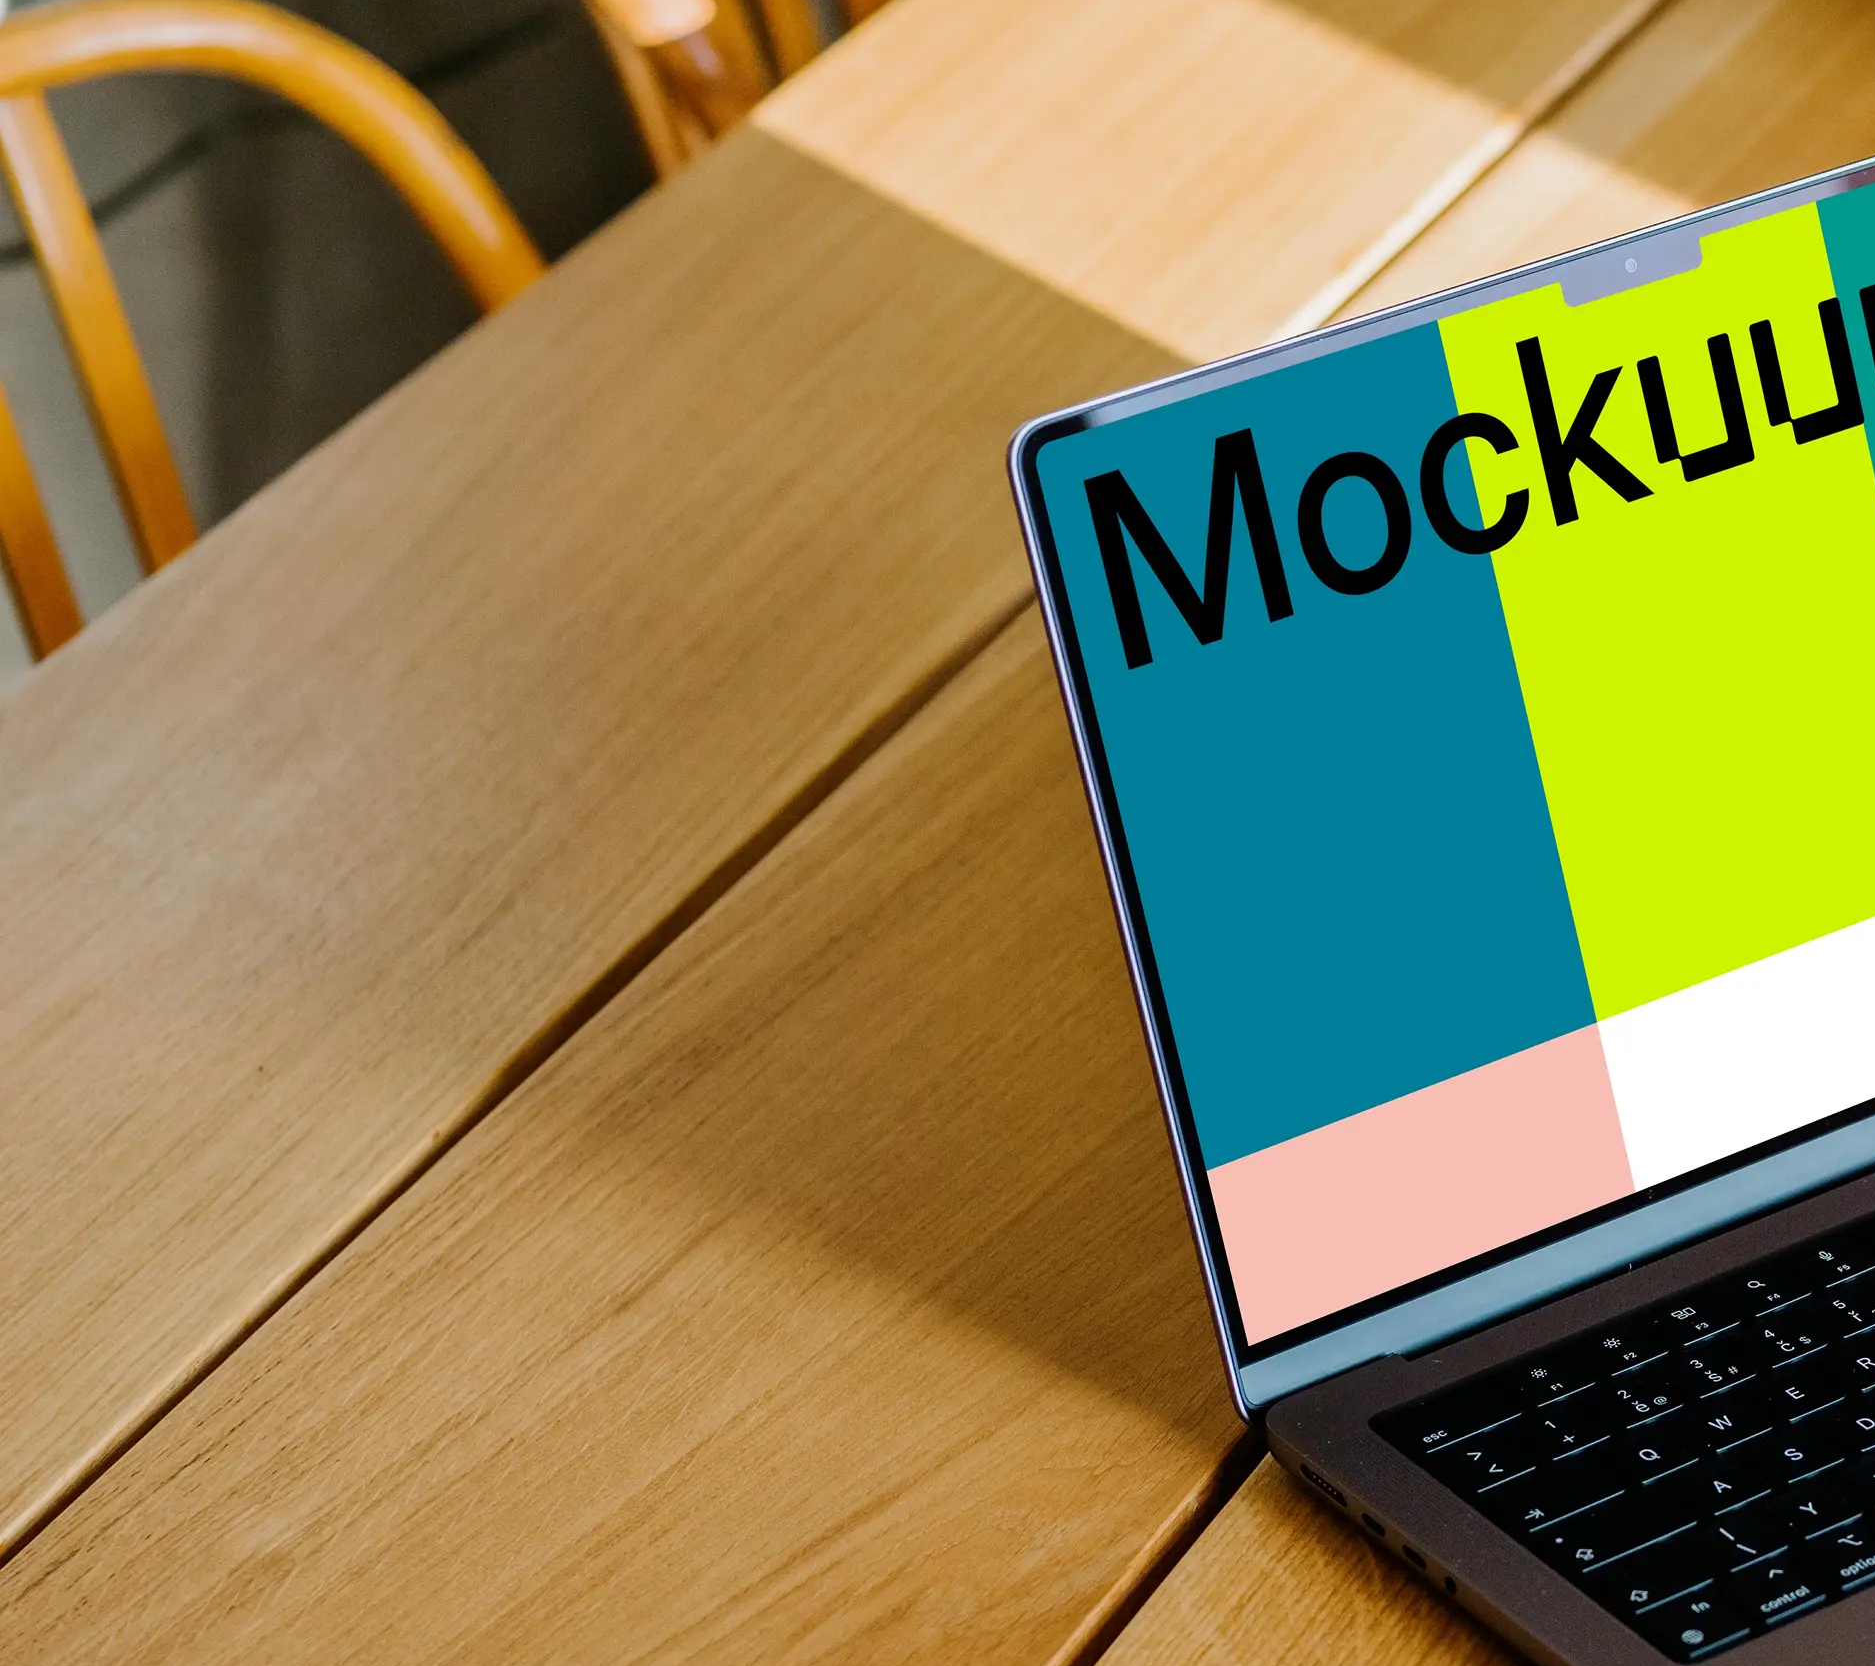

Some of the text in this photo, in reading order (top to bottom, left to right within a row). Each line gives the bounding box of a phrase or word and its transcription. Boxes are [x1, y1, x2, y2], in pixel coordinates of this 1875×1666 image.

[1836, 1263, 1851, 1273] F5
[1766, 1293, 1781, 1302] F4
[1832, 1299, 1847, 1310] 5
[1694, 1322, 1710, 1331] F3
[1764, 1329, 1776, 1338] 4
[1622, 1351, 1638, 1361] F2
[1689, 1359, 1704, 1369] 3
[1550, 1382, 1564, 1391] F1
[1617, 1389, 1632, 1400] 2
[1784, 1386, 1805, 1400] E
[1653, 1395, 1668, 1406] @
[1544, 1420, 1556, 1429] 1
[1707, 1414, 1733, 1431] W
[1855, 1417, 1875, 1431] D
[1422, 1430, 1448, 1444] esc
[1638, 1448, 1661, 1461] Q
[1783, 1448, 1804, 1461] S
[1713, 1480, 1733, 1494] A
[1798, 1501, 1818, 1516] Y
[1759, 1587, 1810, 1613] control
[1690, 1601, 1711, 1614] fn
